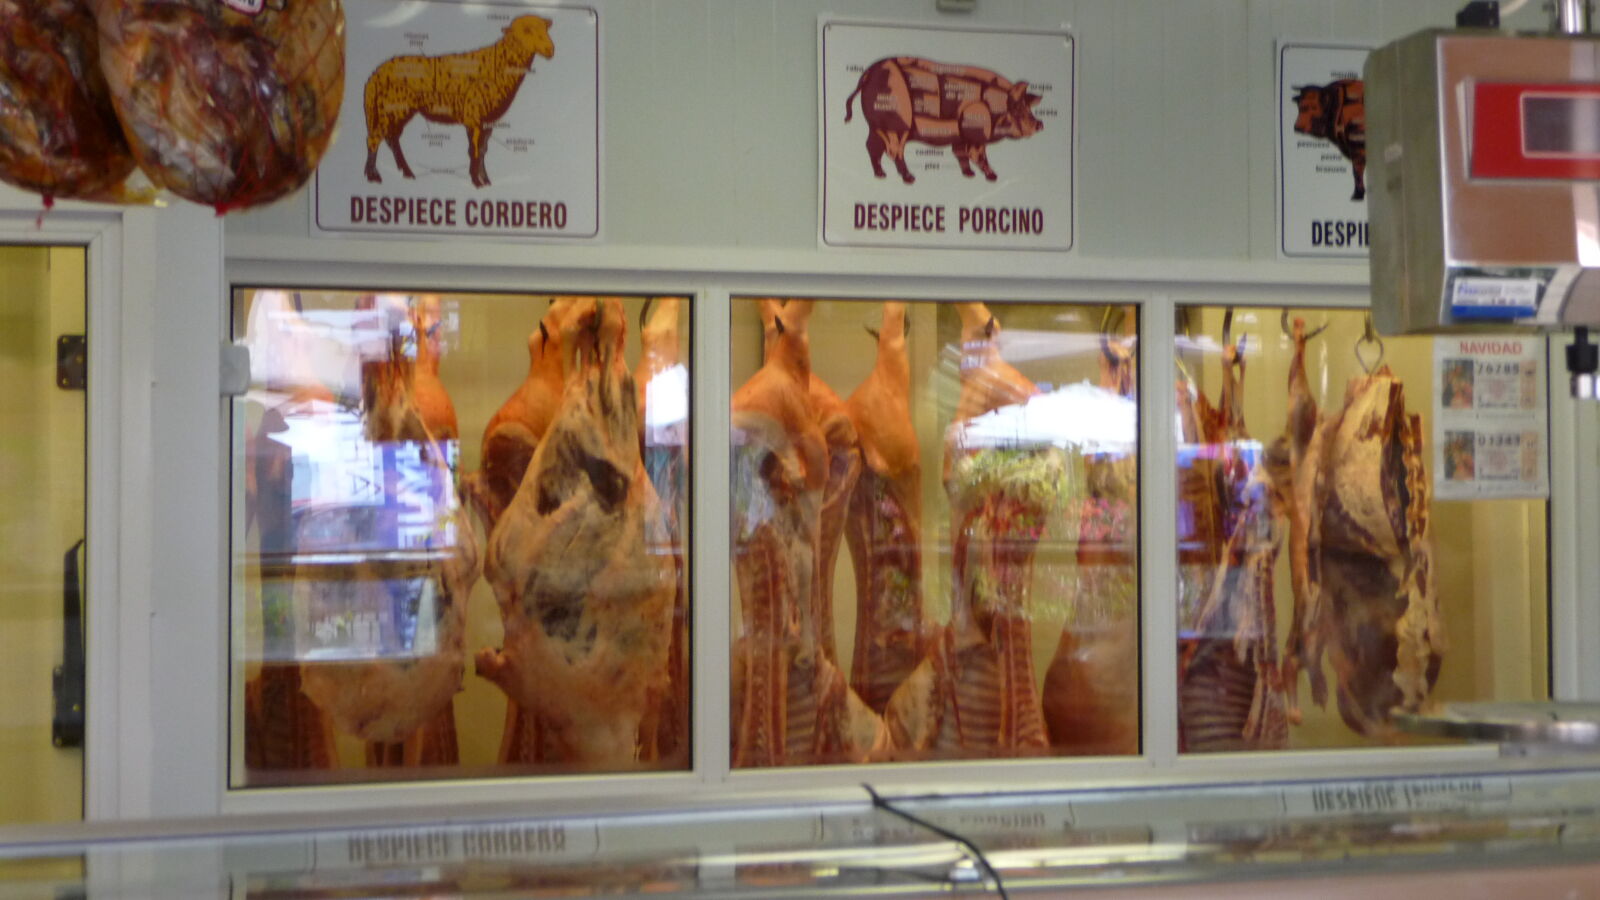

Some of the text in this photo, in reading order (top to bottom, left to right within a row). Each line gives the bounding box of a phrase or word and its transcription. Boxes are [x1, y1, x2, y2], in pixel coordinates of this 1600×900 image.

[351, 196, 567, 228] DESPIECE CORDERO
[854, 203, 1044, 235] DESPIECE PORCINO
[1459, 341, 1523, 355] NAVIDAD
